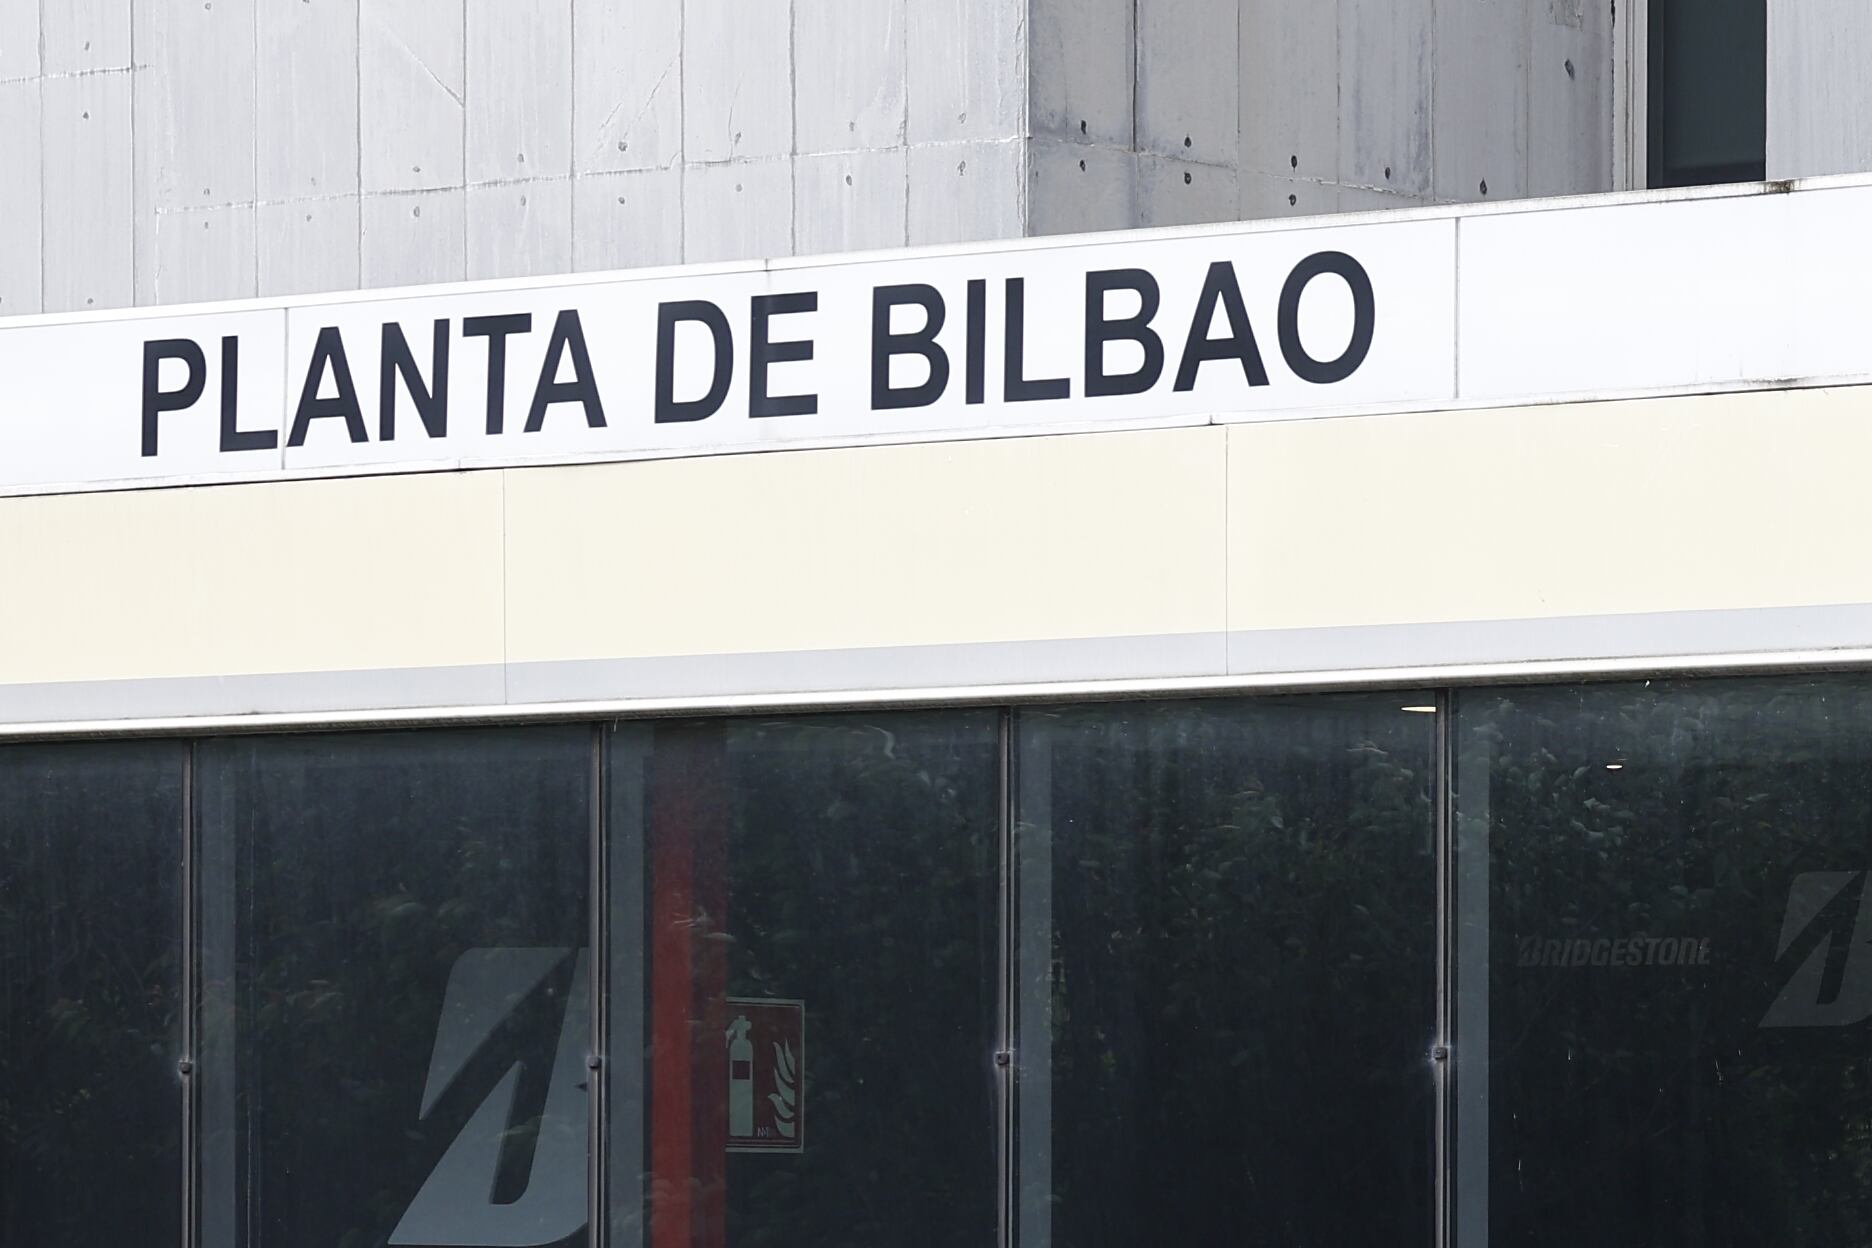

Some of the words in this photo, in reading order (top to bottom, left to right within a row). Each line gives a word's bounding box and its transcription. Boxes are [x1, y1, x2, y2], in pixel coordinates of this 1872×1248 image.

[141, 309, 607, 457] PLANTA
[654, 291, 818, 424] DE
[871, 250, 1375, 411] BILBAO
[1516, 932, 1710, 967] BRIDGESTONE
